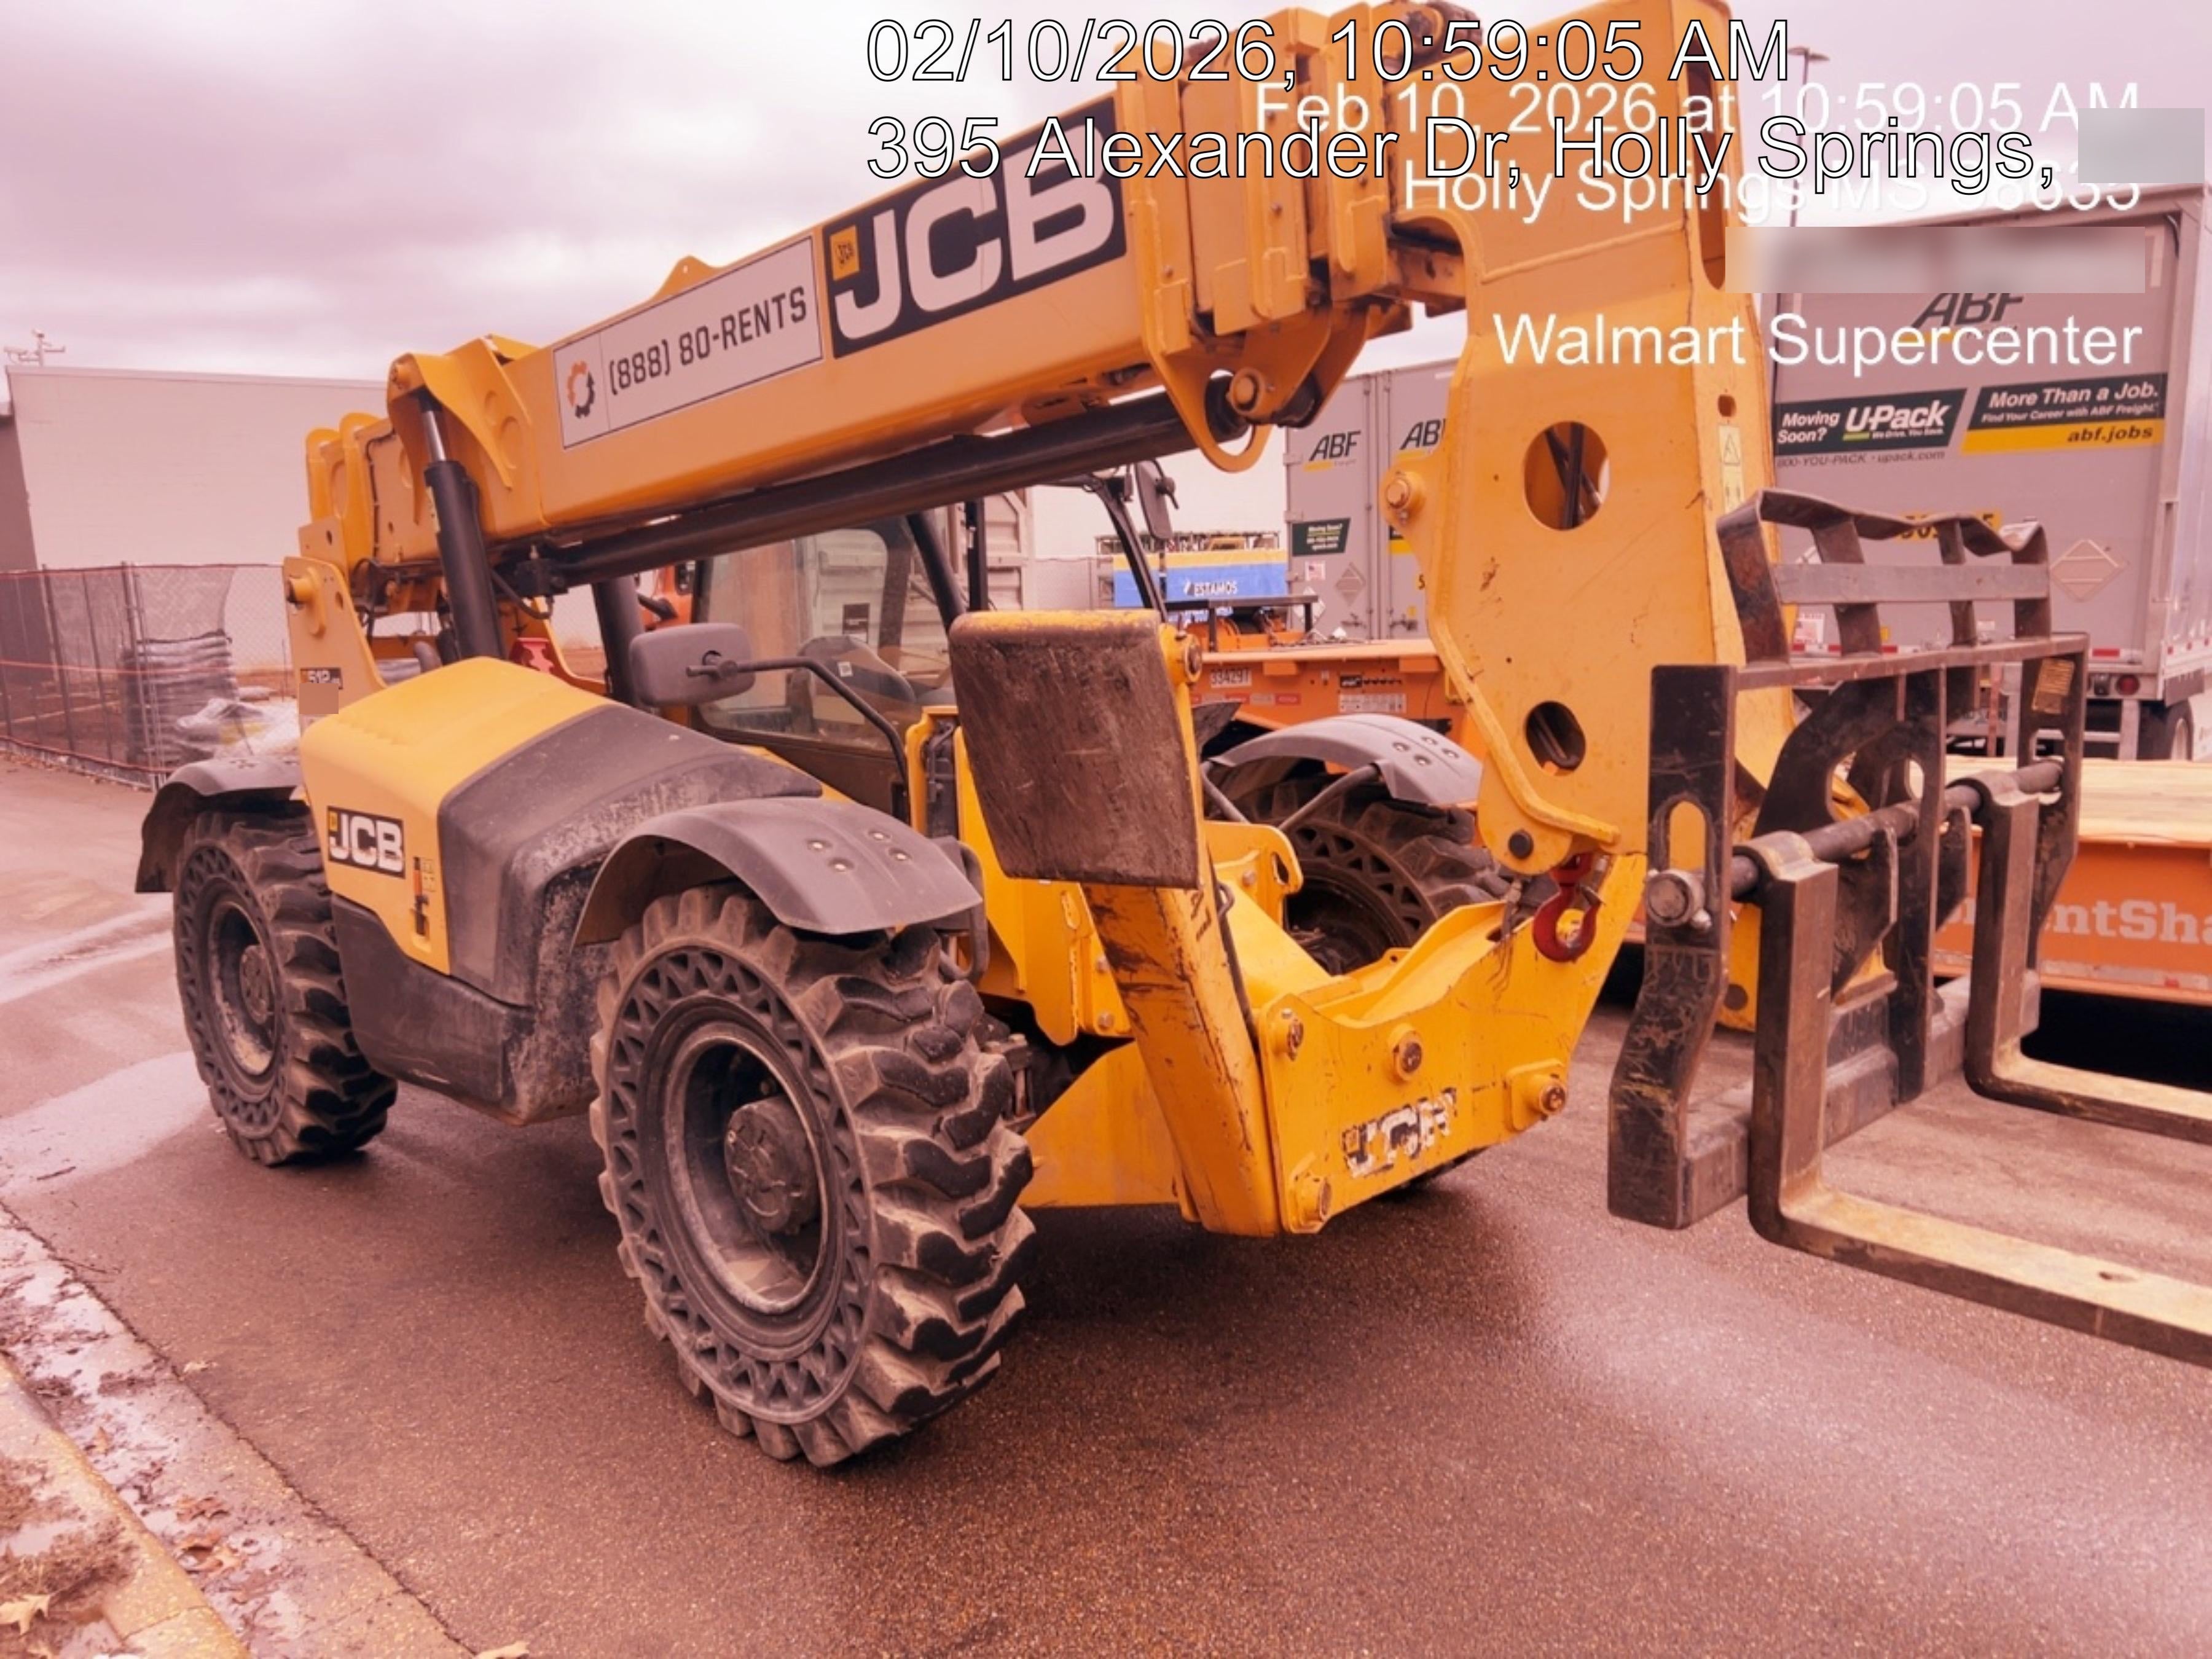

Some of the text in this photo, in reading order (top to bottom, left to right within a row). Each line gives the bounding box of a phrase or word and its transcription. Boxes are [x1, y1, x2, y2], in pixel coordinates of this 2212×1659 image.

[834, 125, 1115, 340] JCB
[609, 285, 807, 395] (888) 80-RENTS
[1988, 381, 2159, 409] More Than a Job.
[1782, 410, 1841, 428] Moving
[1846, 399, 1952, 432] U-Pack
[1308, 429, 1362, 462] ABF
[1776, 427, 1828, 444] Soon?
[2068, 425, 2154, 443] abf.jobs
[329, 812, 403, 873] JCB
